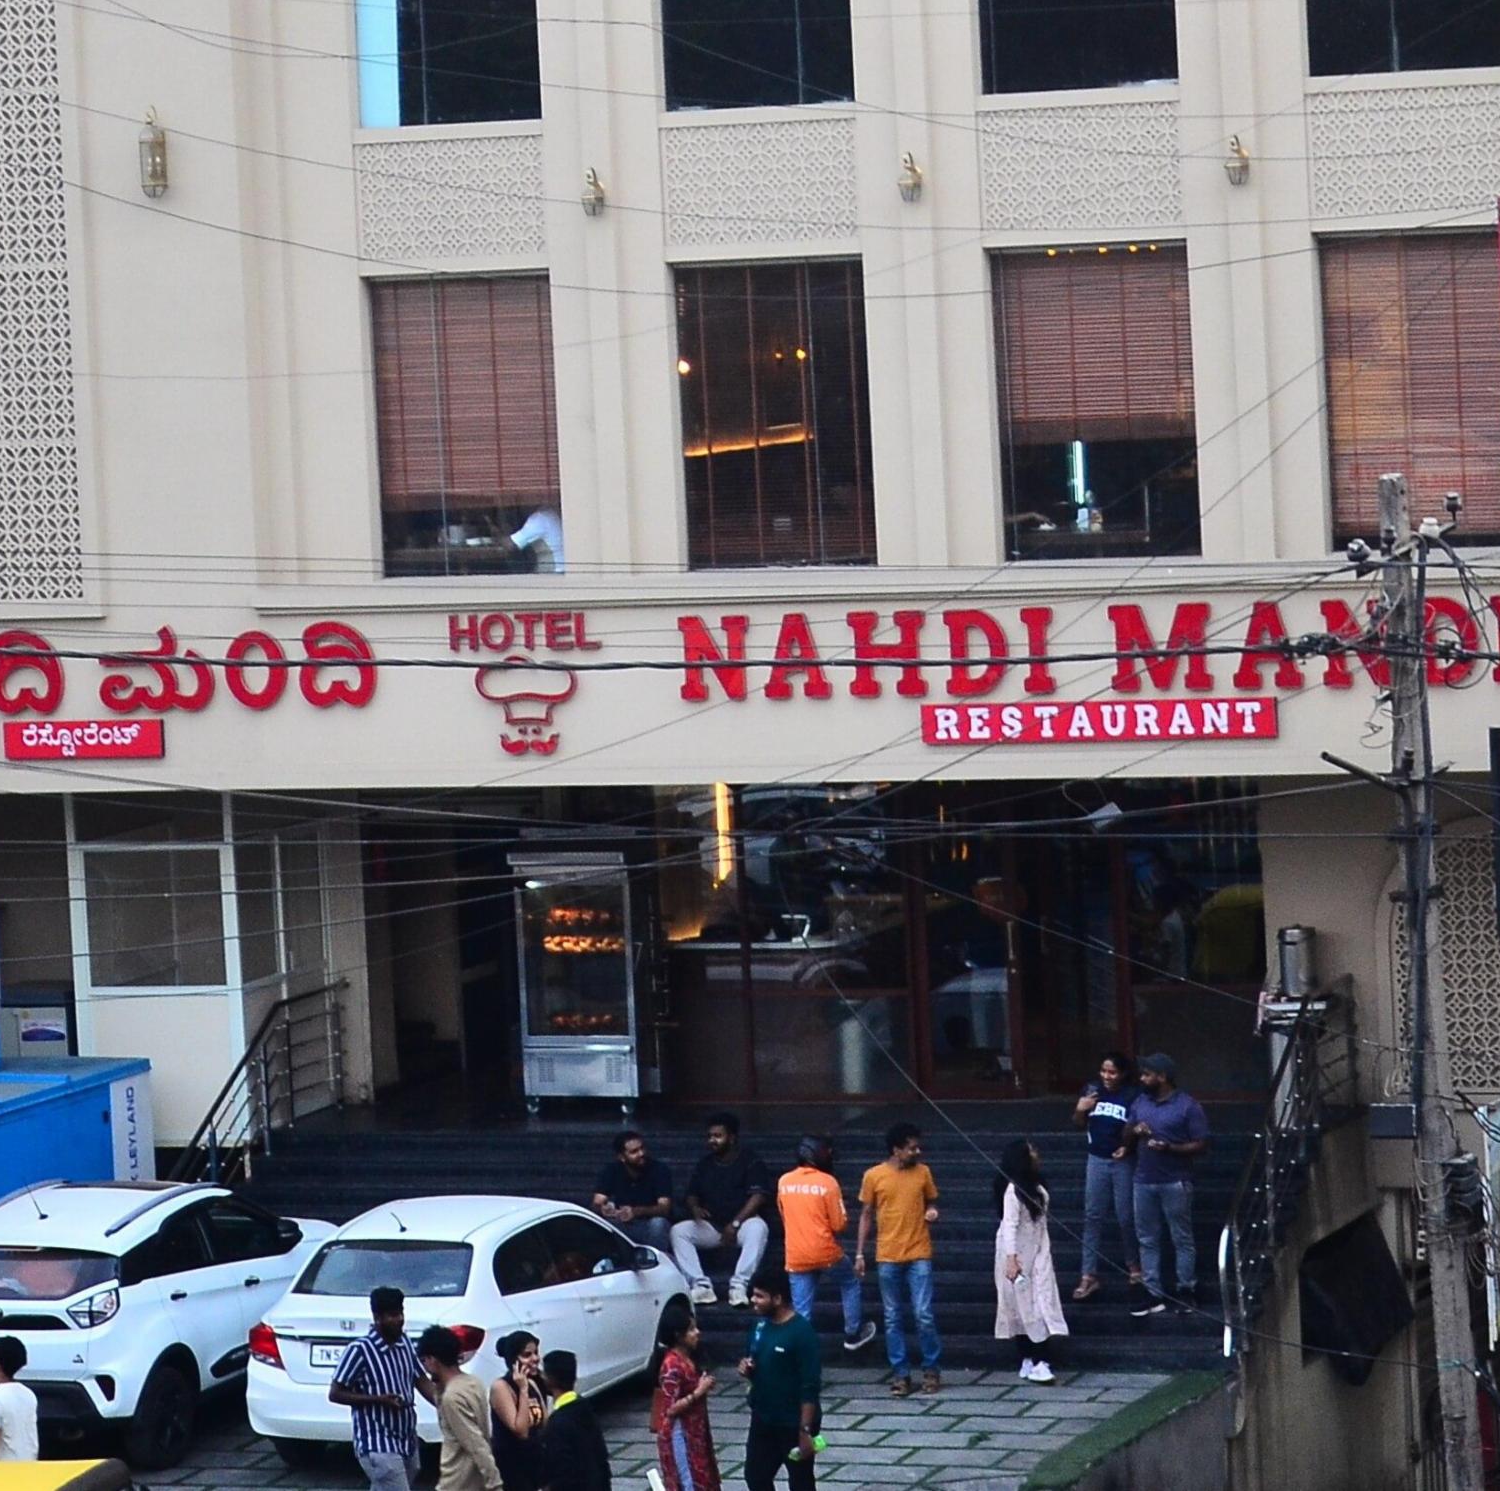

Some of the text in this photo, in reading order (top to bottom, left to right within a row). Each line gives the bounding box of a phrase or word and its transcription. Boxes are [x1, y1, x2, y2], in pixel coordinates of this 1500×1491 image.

[448, 610, 602, 653] HOTEL
[677, 605, 1058, 703] NAHDI
[98, 621, 381, 714] ಮಂದಿ
[933, 700, 1262, 741] RESTAURANT
[125, 1086, 139, 1170] LEYLAND
[1088, 1101, 1129, 1123] EBEL
